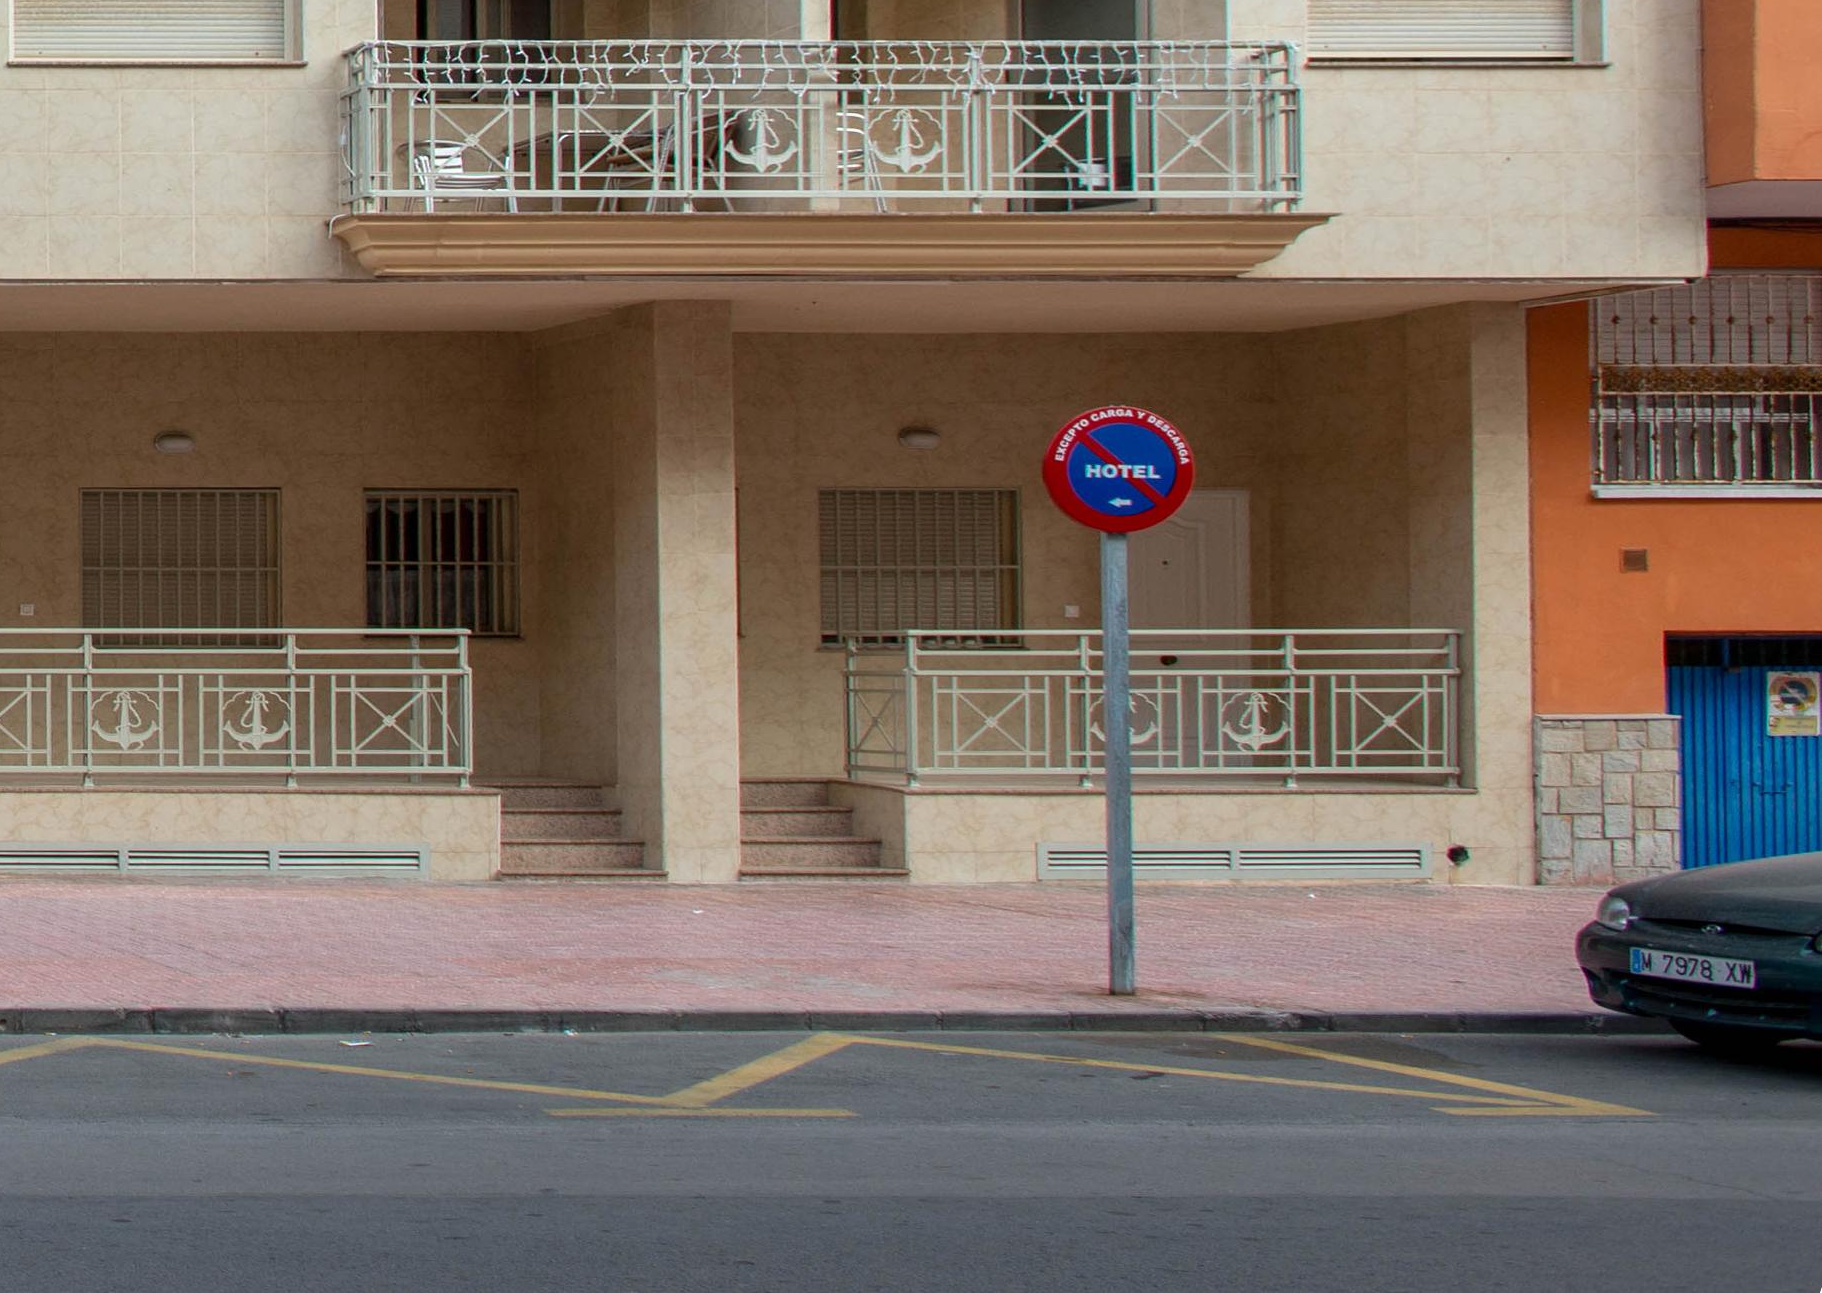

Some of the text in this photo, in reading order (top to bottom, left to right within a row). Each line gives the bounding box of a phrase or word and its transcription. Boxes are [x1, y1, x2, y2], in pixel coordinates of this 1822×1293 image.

[1055, 409, 1190, 465] EXCEPTO CARGA Y DESCARGA
[1085, 464, 1161, 479] HOTEL
[1641, 952, 1653, 971] M
[1662, 954, 1713, 981] 7978
